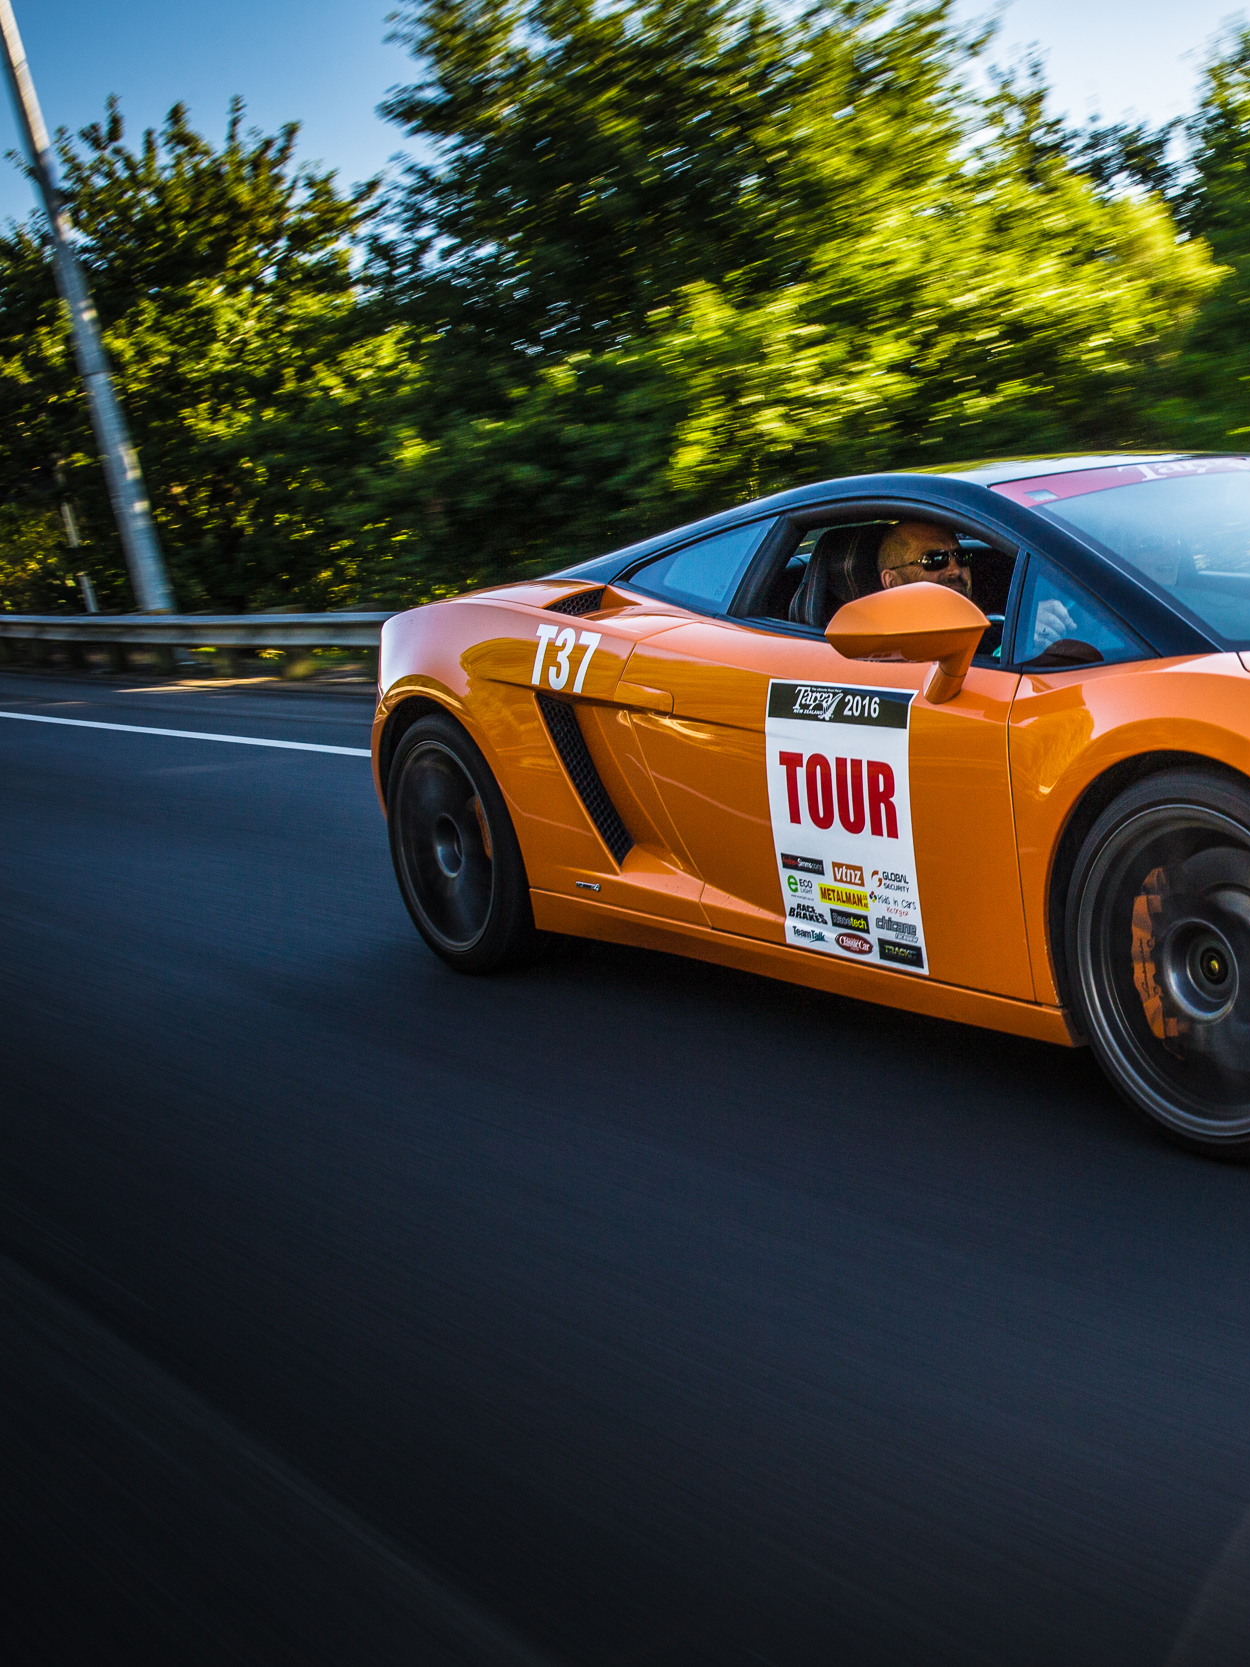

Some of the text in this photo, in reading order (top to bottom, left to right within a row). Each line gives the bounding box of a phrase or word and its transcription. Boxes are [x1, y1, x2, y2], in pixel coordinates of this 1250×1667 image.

[531, 623, 602, 693] T37
[793, 686, 880, 718] Targa 2016
[779, 750, 899, 839] TOUR
[799, 878, 813, 889] ECO
[834, 865, 862, 884] vtnz
[882, 871, 909, 885] GLOBAL
[820, 886, 863, 907] METALMAN
[884, 883, 910, 893] SECURITY
[788, 906, 828, 925] BRAKES
[796, 903, 818, 914] RACE
[792, 925, 826, 942] TeamTalk
[876, 915, 917, 936] chicane
